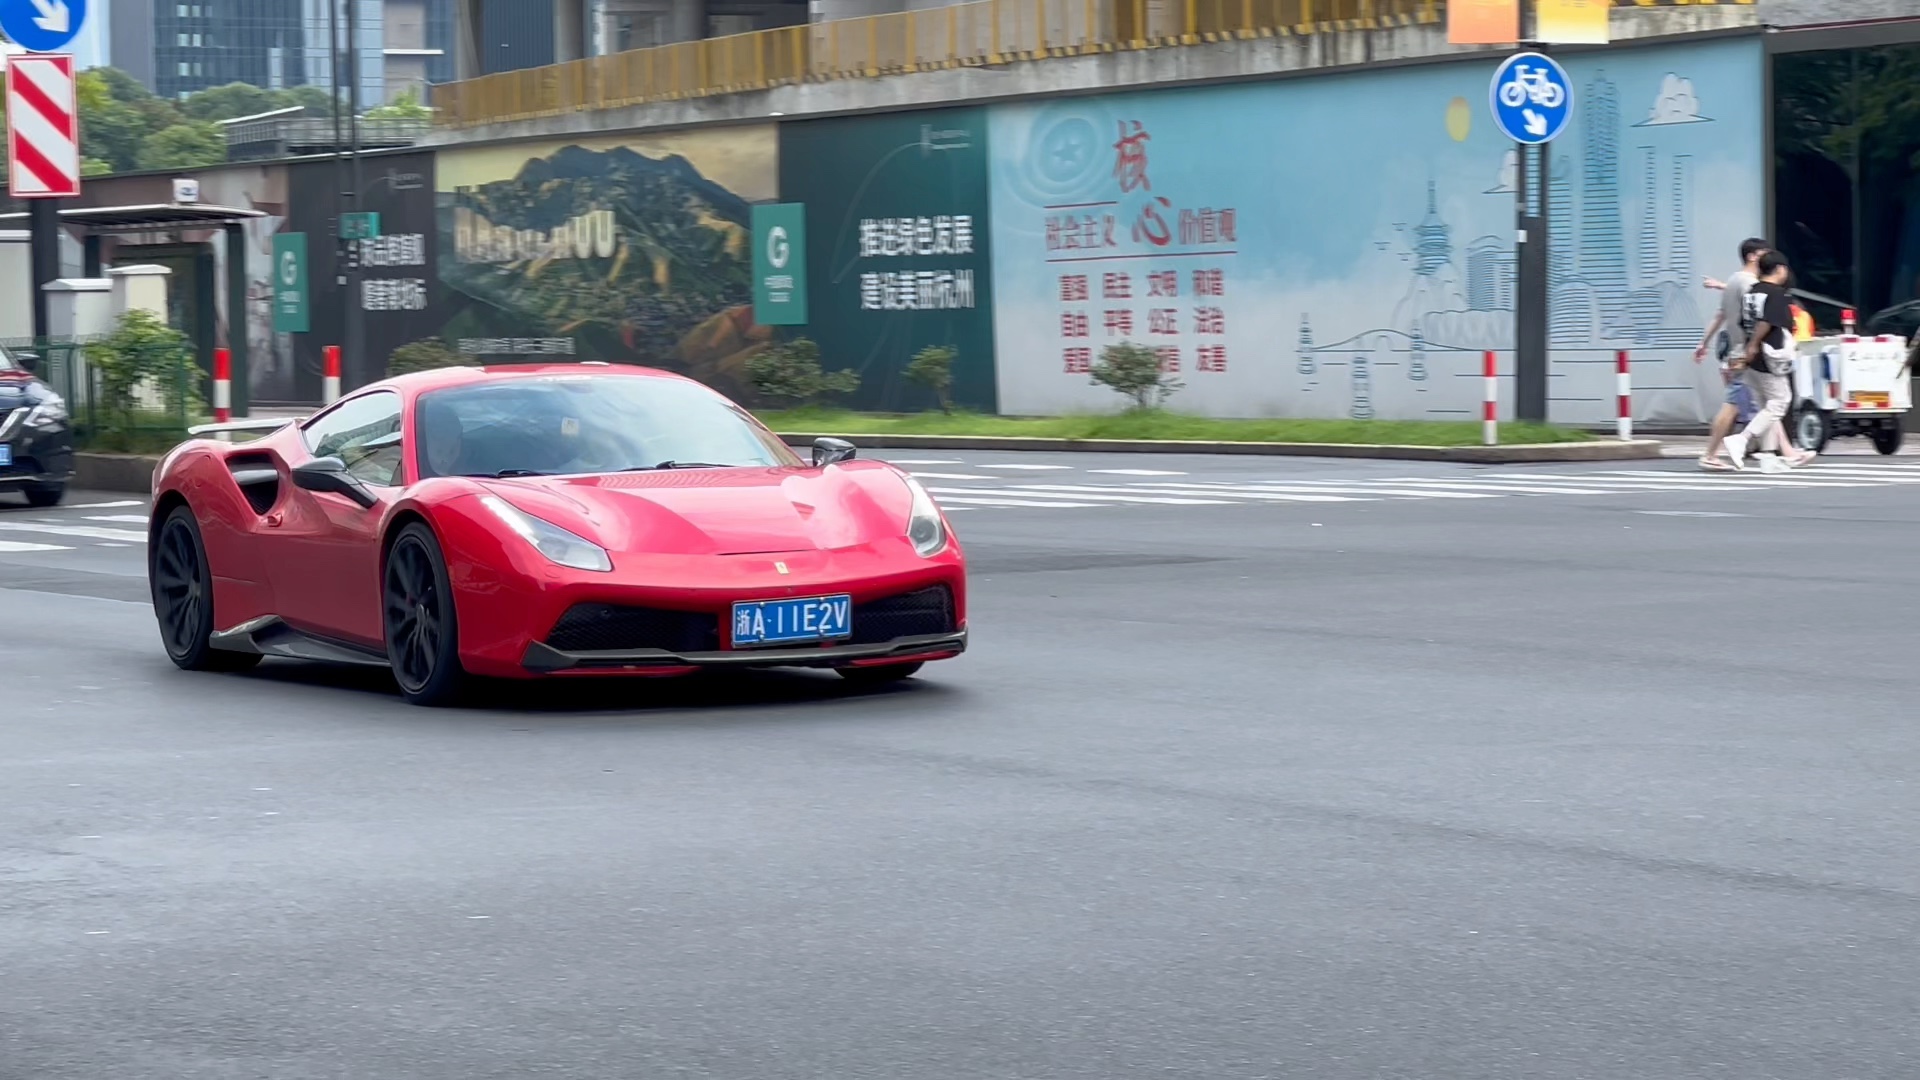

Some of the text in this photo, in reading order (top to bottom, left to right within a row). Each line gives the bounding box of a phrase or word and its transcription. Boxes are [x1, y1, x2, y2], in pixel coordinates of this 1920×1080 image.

[1113, 120, 1151, 193] 核
[860, 215, 974, 257] 推进绿色发展
[1045, 196, 1238, 250] 社会主义 心 价值观
[860, 268, 976, 310] 建设美丽杭州
[1059, 267, 1225, 301] 富强 民主 文明 和谐
[1061, 306, 1225, 338] 自由 平等 公正 法治
[1063, 346, 1092, 374] 爱国
[1196, 343, 1227, 372] 友善
